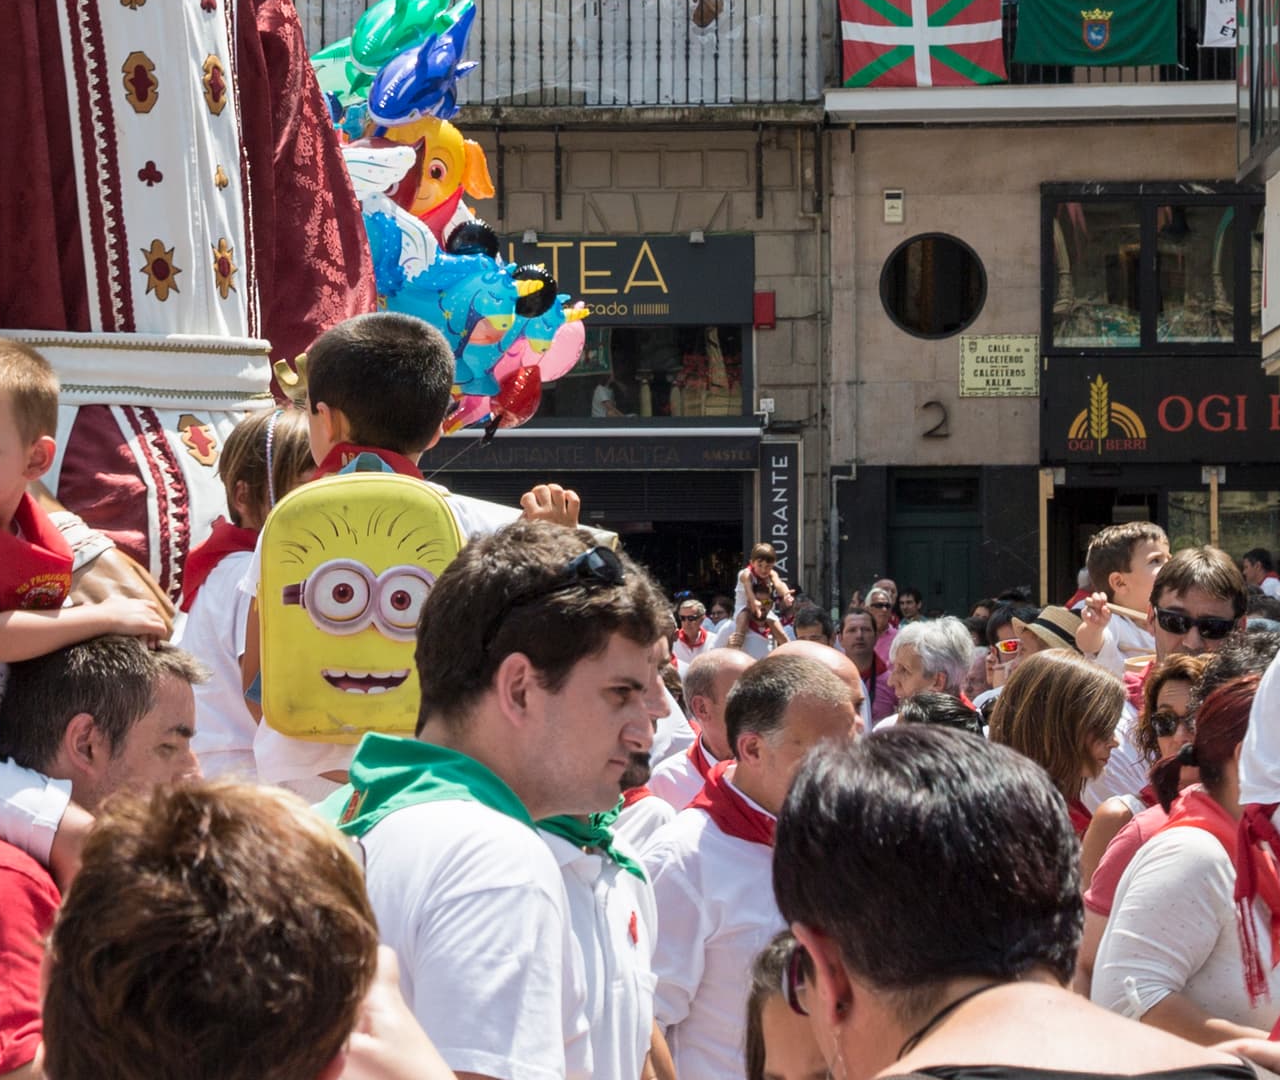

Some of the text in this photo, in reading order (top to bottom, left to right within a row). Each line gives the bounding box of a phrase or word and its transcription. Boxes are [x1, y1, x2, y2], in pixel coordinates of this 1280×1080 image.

[987, 344, 1011, 353] CALLE
[975, 355, 1024, 364] CALCETEROS
[973, 368, 1026, 377] CALCETEROS
[921, 400, 951, 438] 2
[1157, 394, 1248, 433] OGI
[1068, 438, 1147, 452] OGI BERRI
[595, 446, 681, 465] MALTEA
[771, 455, 788, 582] AURANTE
